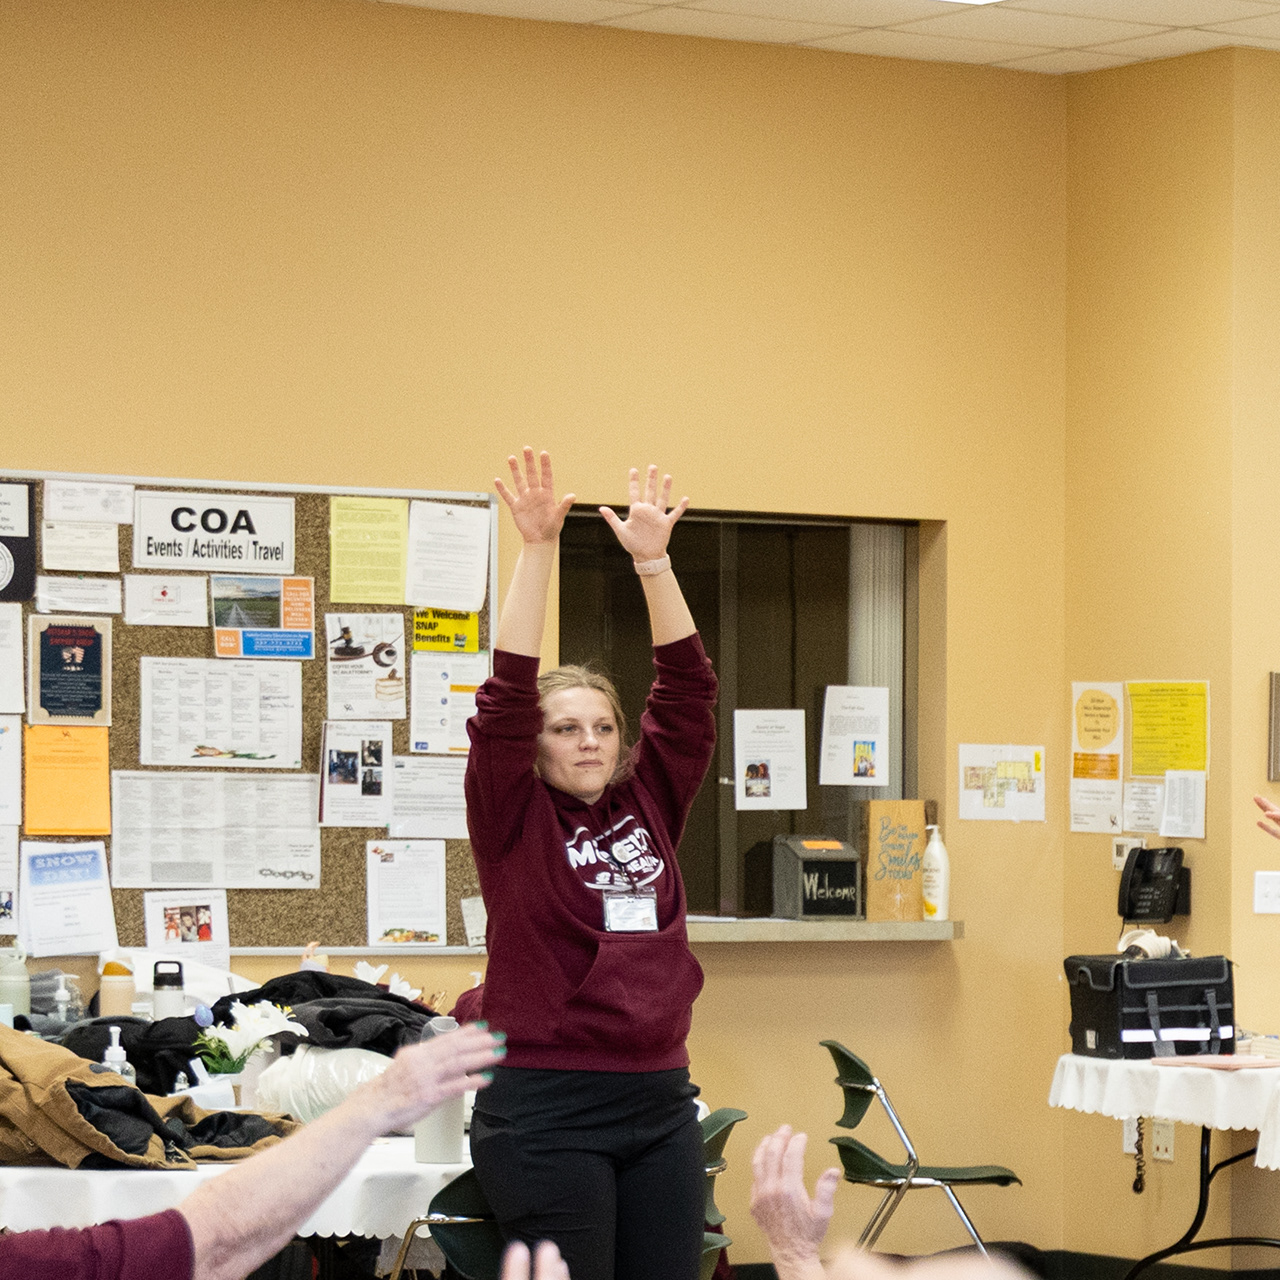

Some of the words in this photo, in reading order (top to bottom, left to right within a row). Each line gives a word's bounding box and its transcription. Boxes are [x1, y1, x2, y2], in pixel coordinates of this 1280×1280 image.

[171, 506, 257, 535] COA
[146, 536, 183, 557] Events
[192, 538, 243, 560] Activities
[252, 540, 284, 561] Travel
[432, 610, 470, 620] Welcome
[415, 621, 439, 631] SNAP
[415, 633, 451, 643] Benefits
[35, 853, 95, 868] SNOW
[803, 872, 856, 901] Welcome
